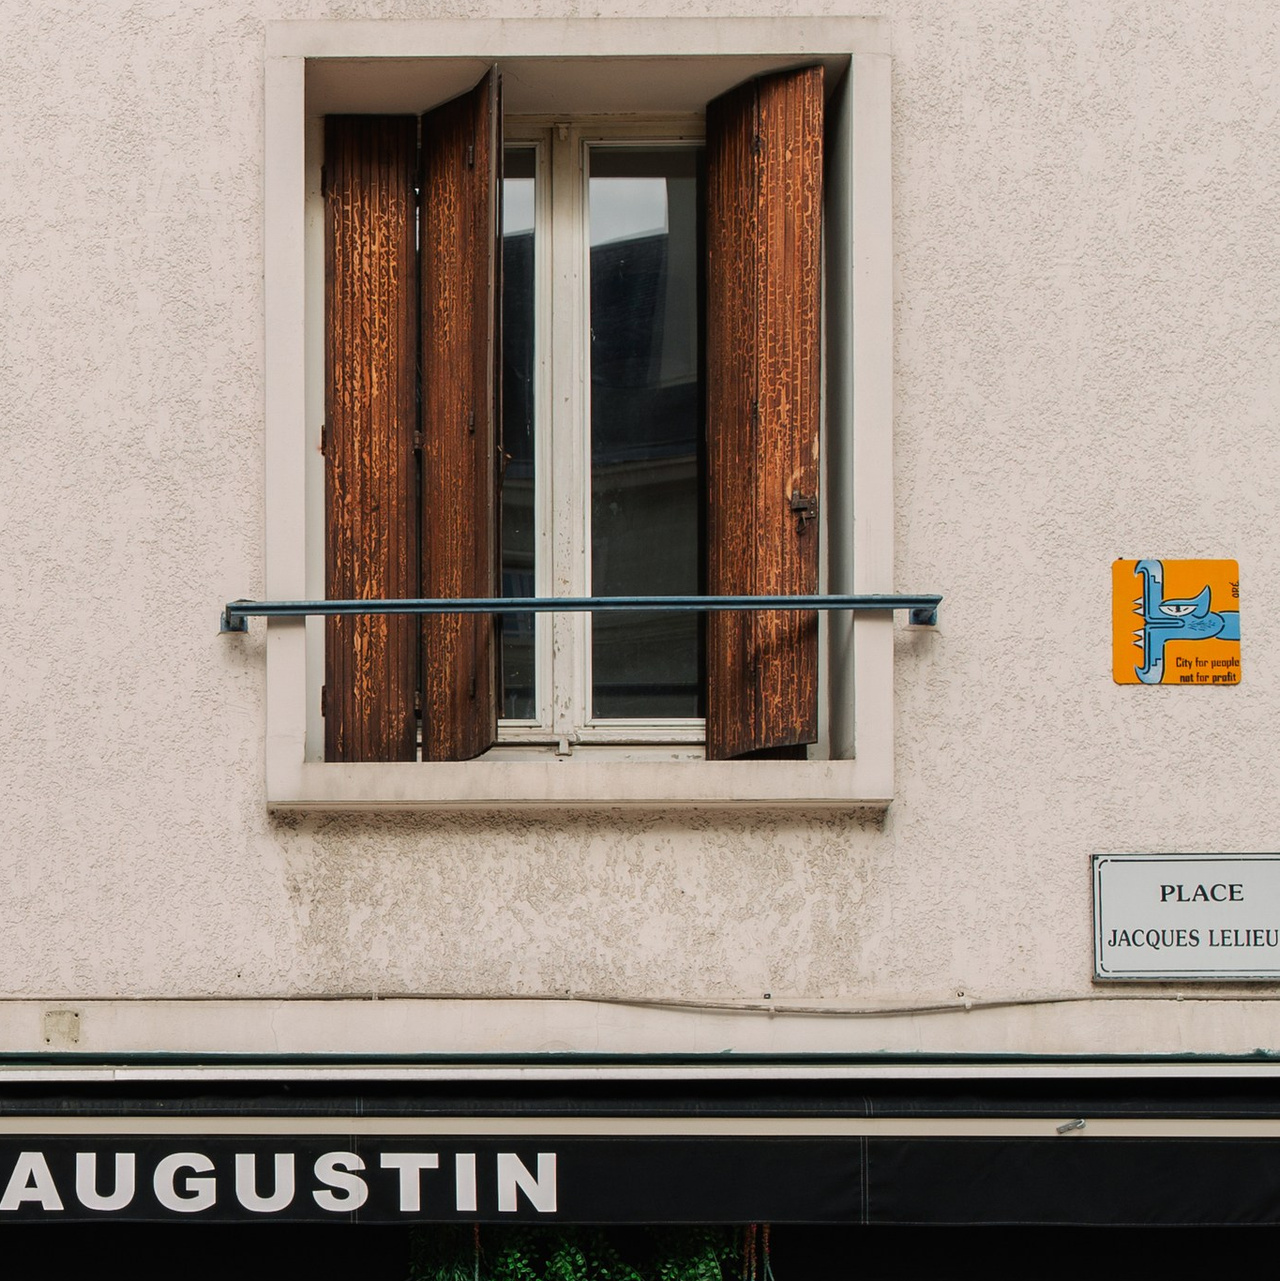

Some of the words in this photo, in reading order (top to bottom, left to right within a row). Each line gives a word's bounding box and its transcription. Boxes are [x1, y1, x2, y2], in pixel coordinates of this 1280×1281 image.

[1176, 657, 1193, 670] City
[1195, 657, 1209, 668] for
[1211, 656, 1240, 670] people
[1180, 673, 1194, 683] not
[1196, 672, 1210, 683] for
[1212, 671, 1237, 684] profit
[1160, 883, 1244, 903] PLACE
[1107, 928, 1200, 950] JACQUES
